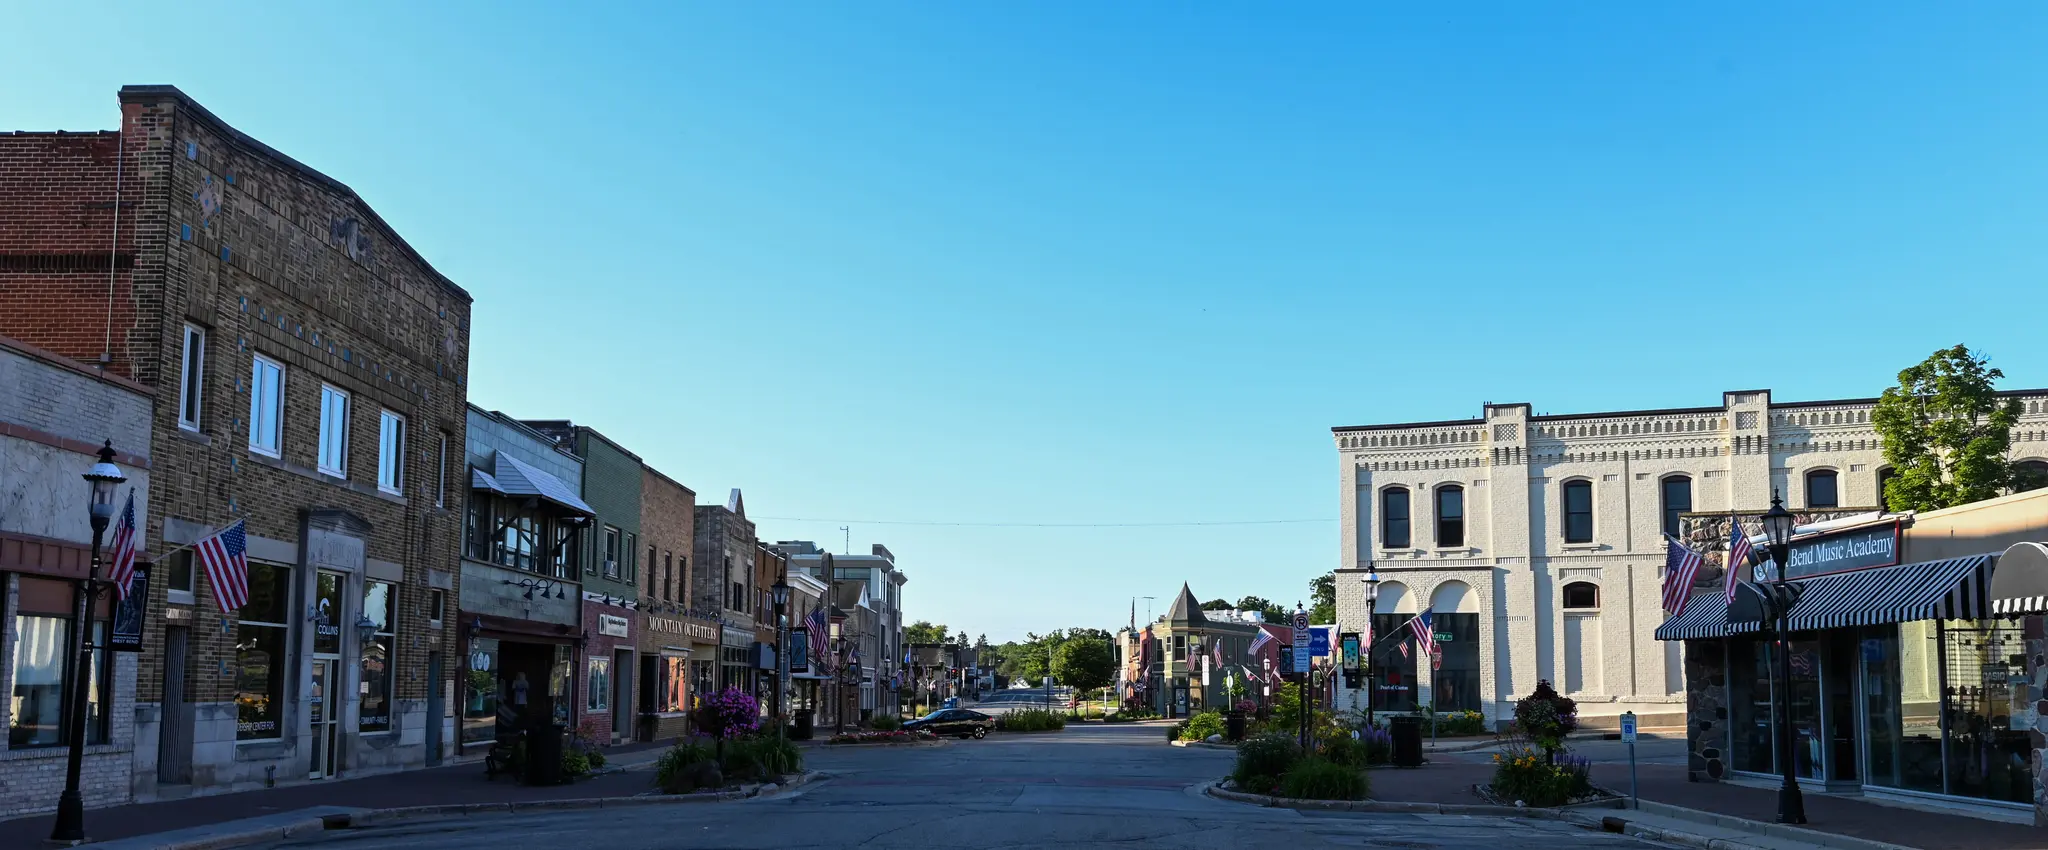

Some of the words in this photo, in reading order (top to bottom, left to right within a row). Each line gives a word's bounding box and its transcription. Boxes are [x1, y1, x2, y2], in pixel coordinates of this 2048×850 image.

[1791, 544, 1813, 567] Bend
[1815, 540, 1843, 563] Music
[1845, 534, 1894, 558] Academy
[318, 625, 338, 635] COLLINS
[648, 616, 683, 634] MOUNTAIN
[684, 622, 717, 640] OUTFITTERS
[1983, 671, 2005, 680] CASIO
